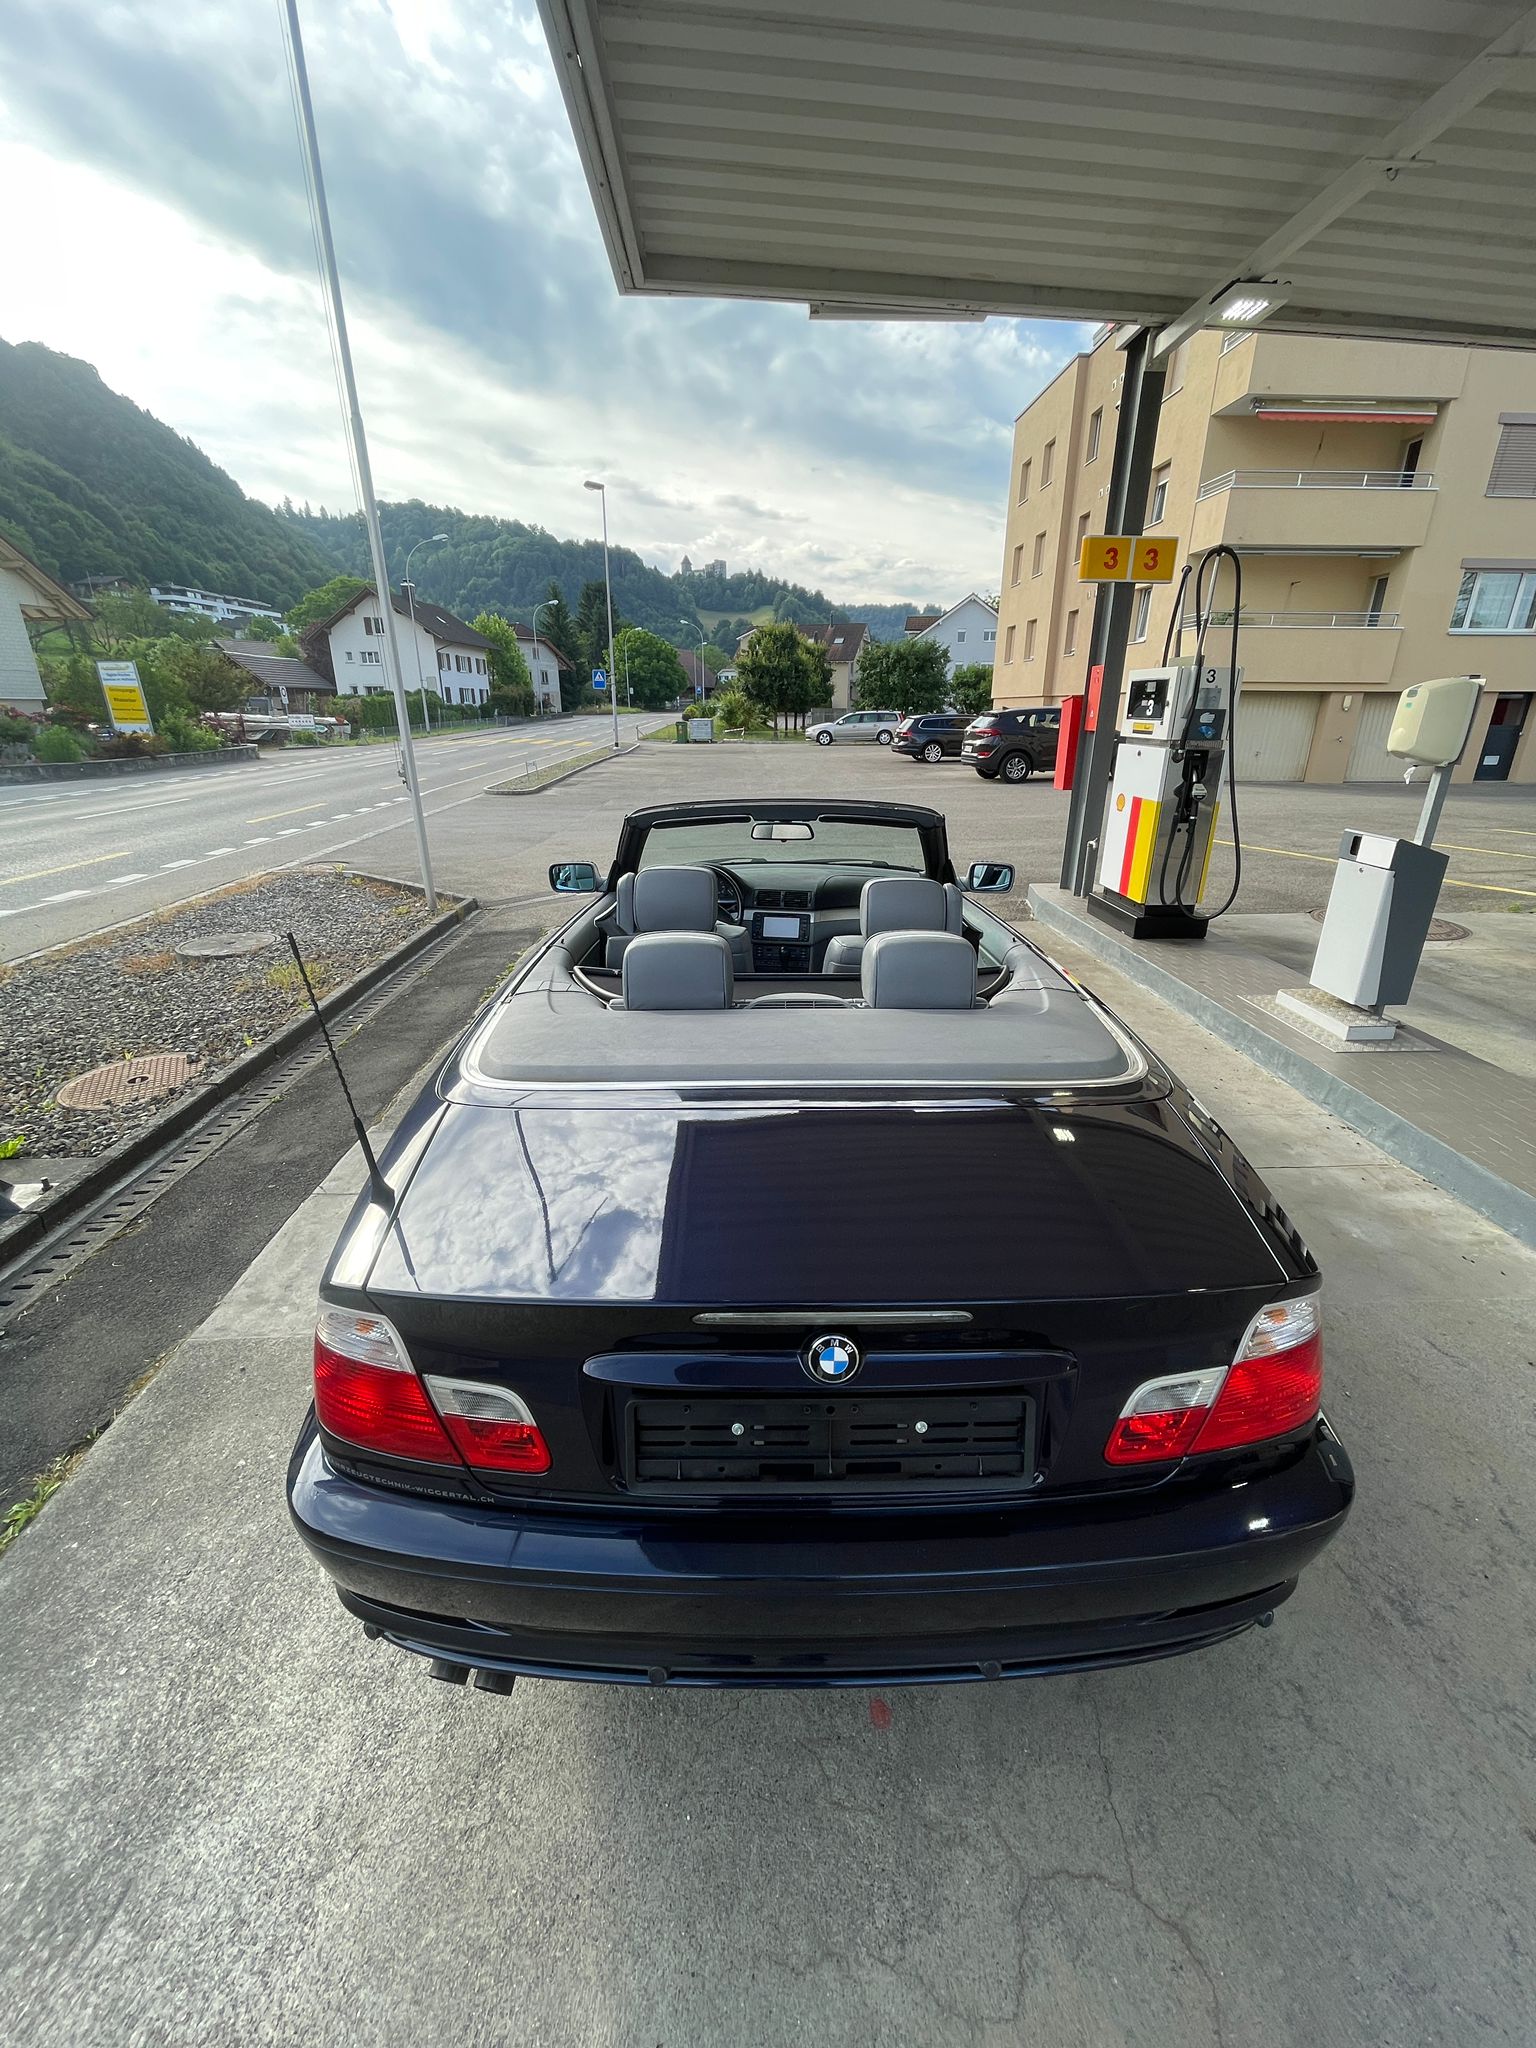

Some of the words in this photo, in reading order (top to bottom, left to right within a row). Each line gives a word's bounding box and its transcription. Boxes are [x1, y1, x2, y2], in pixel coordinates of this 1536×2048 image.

[1103, 547, 1119, 570] 3
[1143, 548, 1159, 571] 3
[1206, 669, 1216, 683] 3
[1145, 699, 1155, 716] 3
[815, 1339, 854, 1354] BMW
[327, 1455, 496, 1504] HRZEUGTECHNIK-WIGGERTAL.CH
